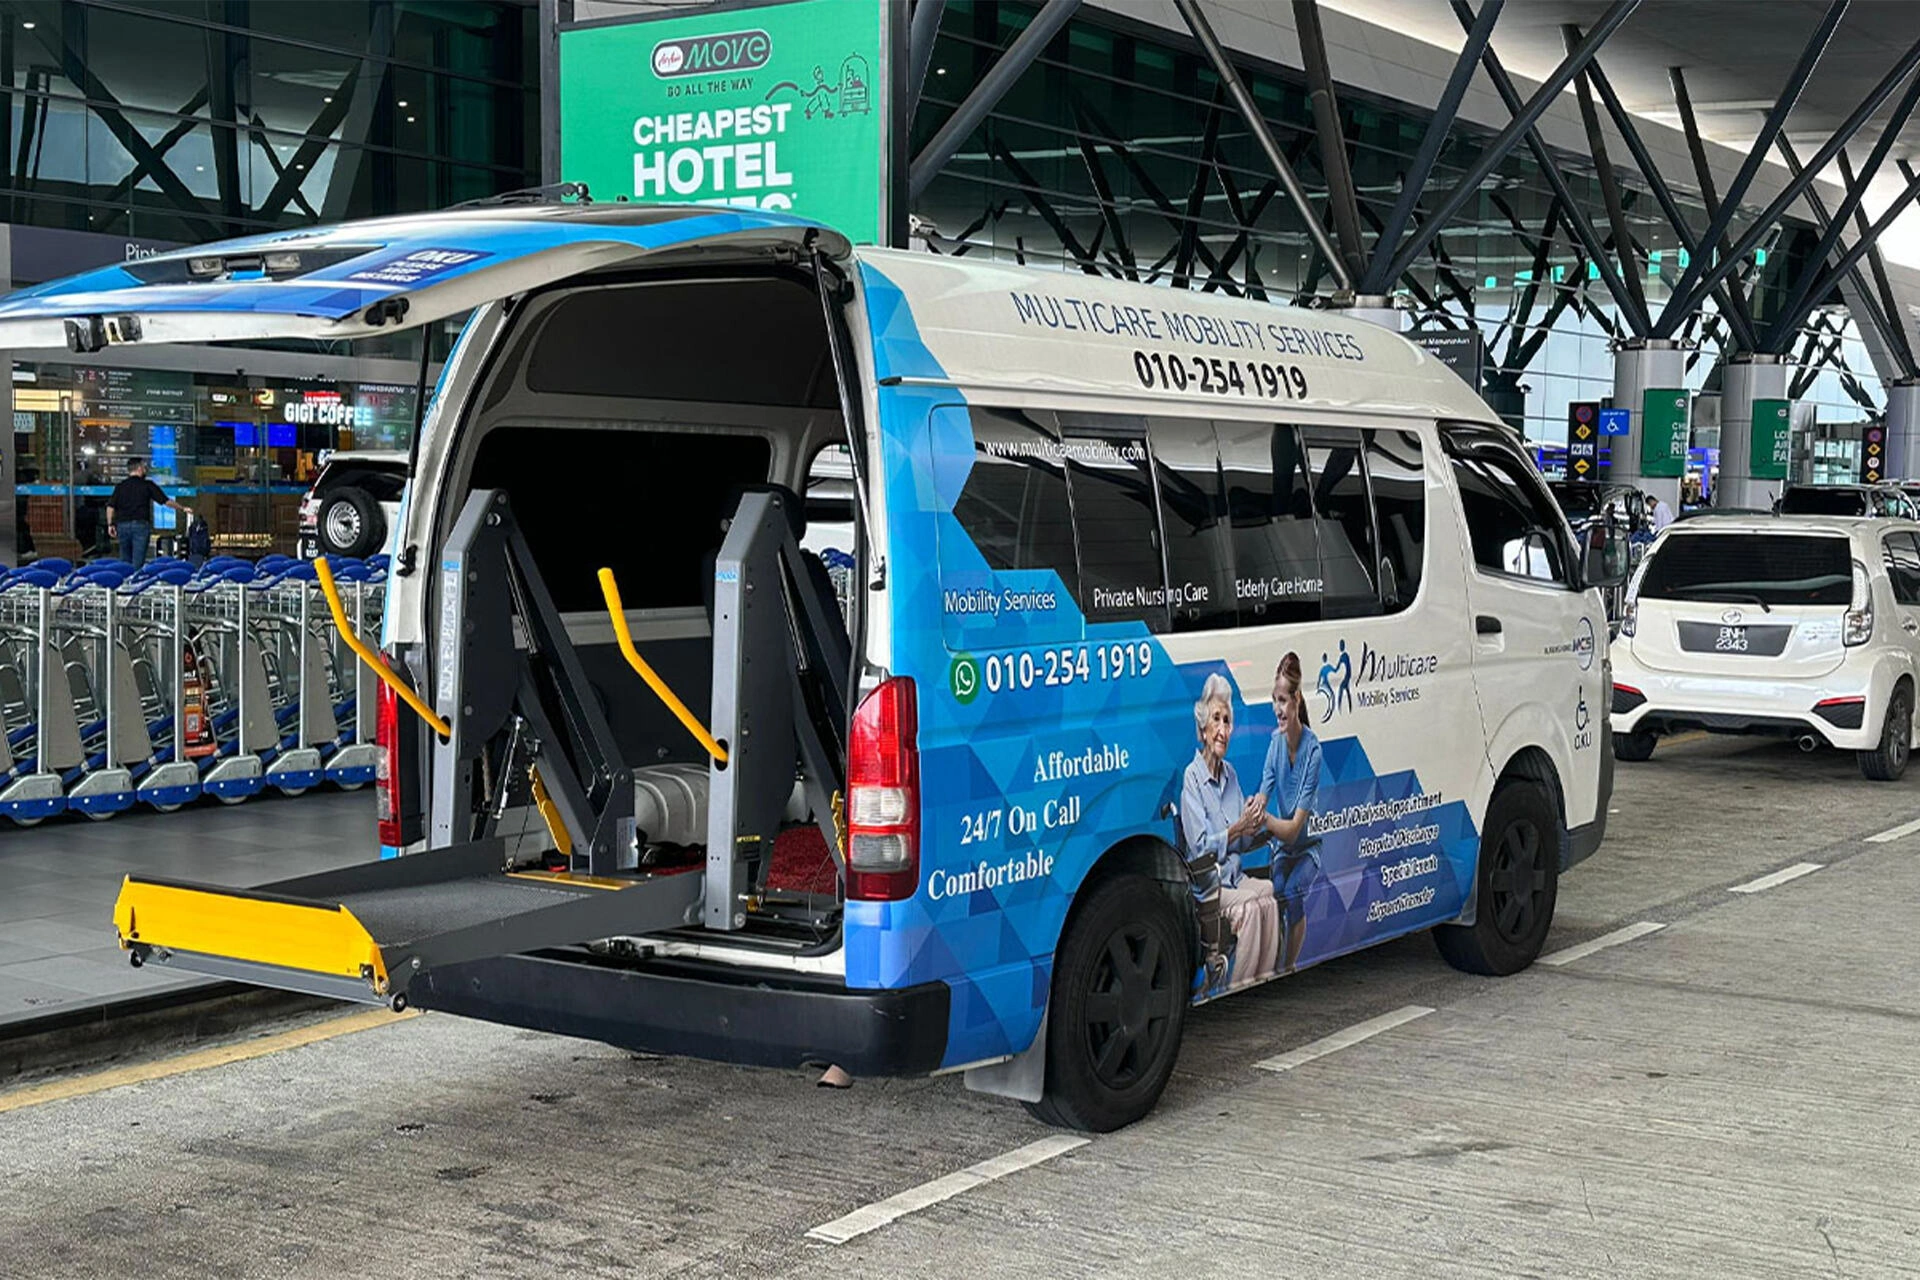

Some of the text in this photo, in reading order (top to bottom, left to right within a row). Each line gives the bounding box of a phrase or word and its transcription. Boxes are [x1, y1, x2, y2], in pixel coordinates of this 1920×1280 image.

[685, 83, 704, 96] ALL
[707, 80, 727, 93] THE
[731, 78, 754, 91] WAY
[633, 103, 792, 146] CHEAPEST
[633, 141, 793, 197] HOTEL
[1010, 291, 1365, 361] MULTICARE MOBILITY SERVICES
[1133, 350, 1309, 400] 010-254 1919
[284, 402, 373, 427] GIGI COFFEE
[944, 588, 1057, 617] Mobility Services
[1094, 582, 1209, 608] Private Nursing Care
[1235, 576, 1324, 599] Elderly Care Home
[985, 642, 1152, 692] 010-254 1919
[1355, 641, 1438, 688] Multicare
[1357, 685, 1421, 708] Mobility Services
[1574, 731, 1592, 750] OKU
[1033, 743, 1130, 783] Affordable
[960, 796, 1081, 845] 24/7 On Call
[928, 850, 1054, 900] Comfortable
